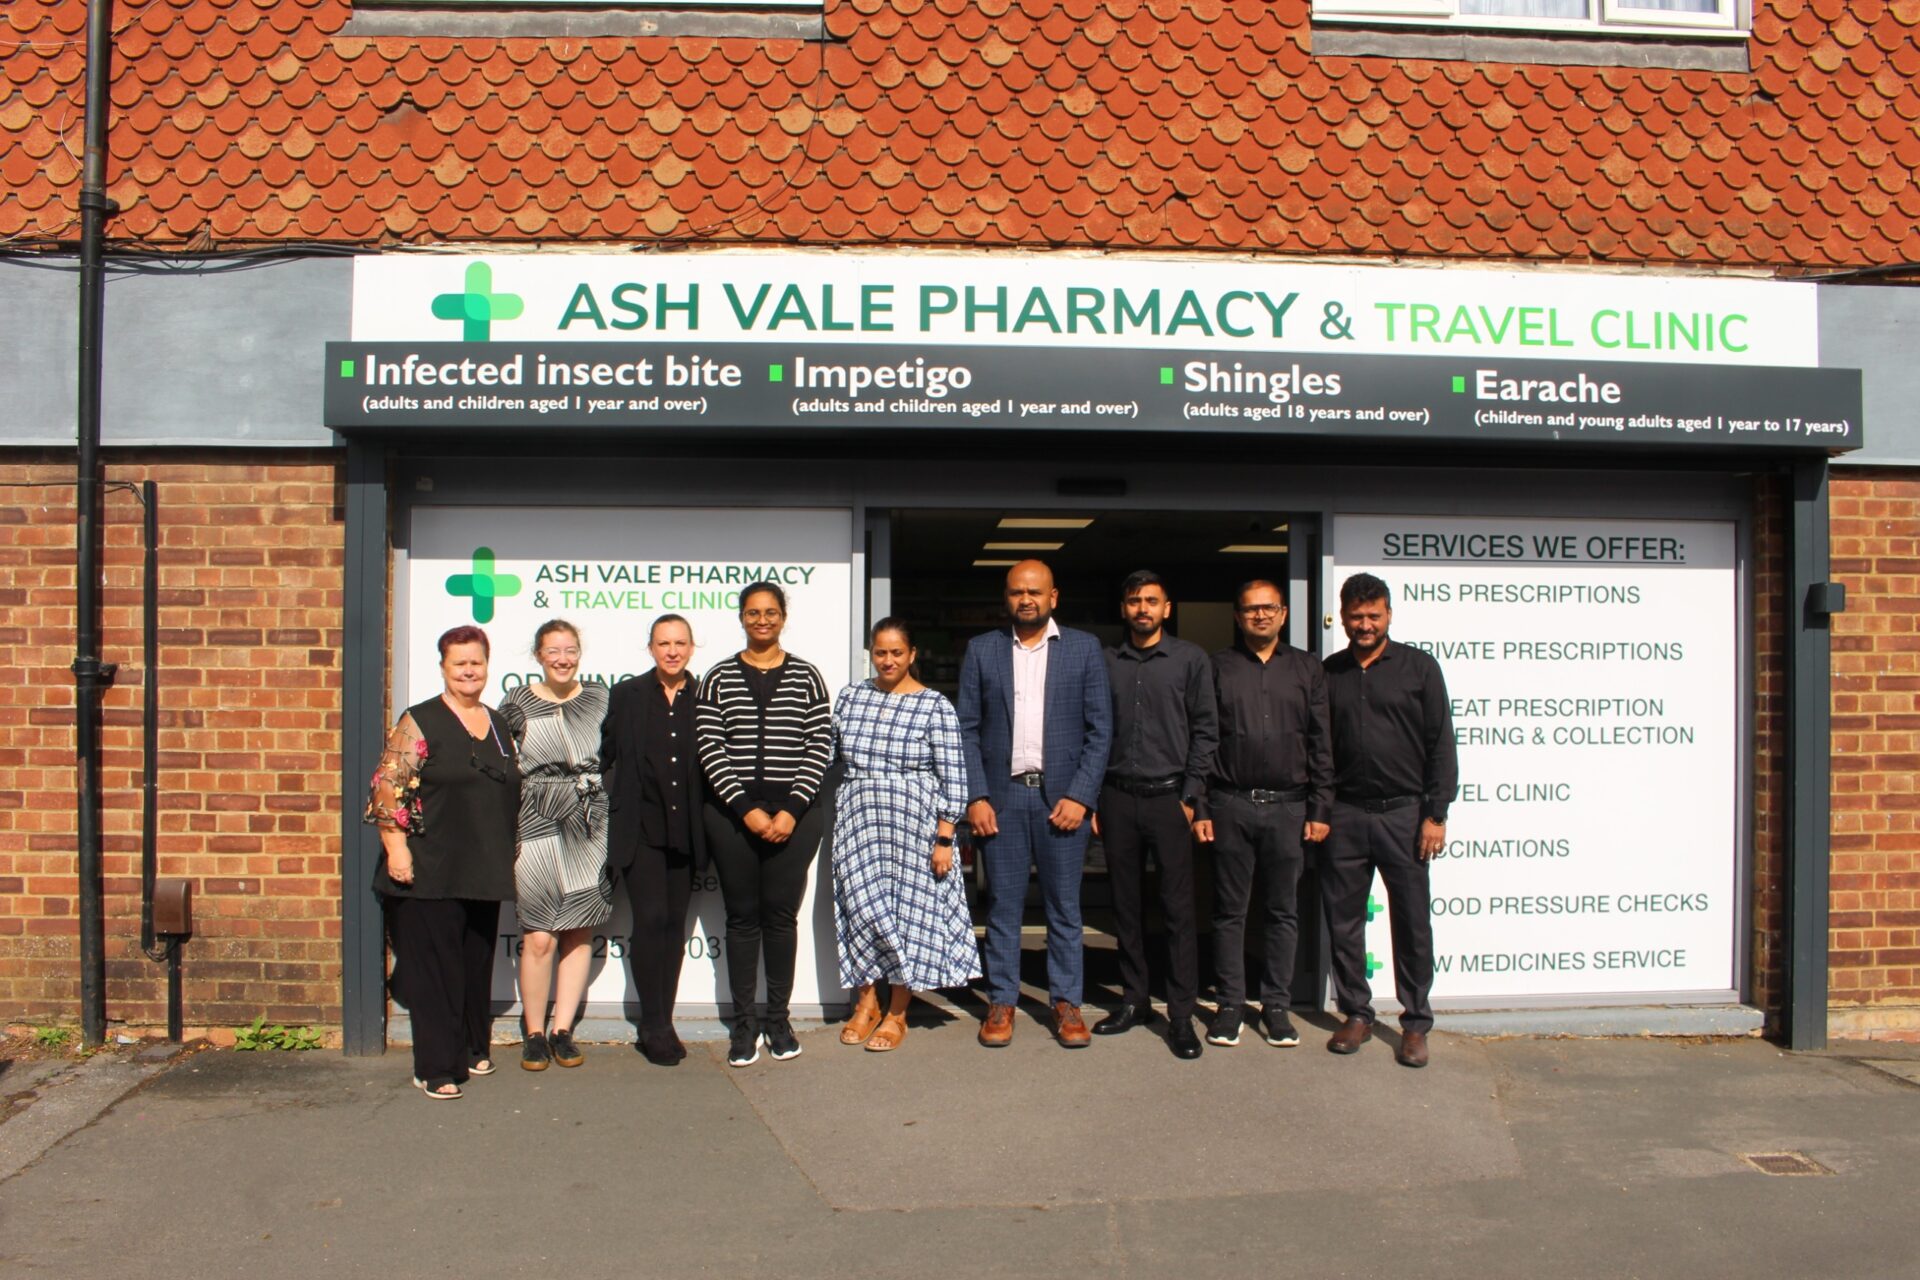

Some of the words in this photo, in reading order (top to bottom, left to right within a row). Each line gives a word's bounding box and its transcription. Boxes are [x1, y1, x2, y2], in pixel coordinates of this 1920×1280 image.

[557, 282, 700, 331] ASH
[722, 283, 895, 332] VALE
[919, 285, 1301, 338] PHARMACY
[1319, 300, 1355, 340] &
[1374, 302, 1575, 347] TRAVEL
[1590, 309, 1750, 353] CLINIC
[365, 353, 523, 386] Infected
[537, 353, 654, 386] insect
[665, 354, 742, 387] bite
[795, 356, 972, 398] Impetigo
[1183, 361, 1342, 403] Shingles
[1475, 369, 1621, 404] Earache
[362, 395, 419, 414] (adults
[422, 395, 454, 410] and
[457, 395, 525, 410] children
[529, 395, 569, 414] aged
[587, 399, 625, 414] year
[628, 396, 660, 411] and
[663, 396, 708, 415] over)
[791, 398, 850, 416] (adults
[853, 398, 885, 413] and
[889, 398, 958, 413] children
[961, 399, 1001, 418] aged
[1019, 402, 1057, 418] year
[1060, 400, 1092, 415] and
[1095, 400, 1139, 419] over)
[1182, 402, 1240, 420] (adults
[1243, 404, 1281, 422] aged
[1286, 404, 1305, 419] 18
[1308, 408, 1352, 423] years
[1355, 406, 1385, 421] and
[1388, 407, 1430, 426] over)
[1474, 409, 1543, 427] (children
[1546, 412, 1575, 427] and
[1578, 416, 1625, 432] young
[1627, 414, 1674, 429] adults
[1676, 415, 1712, 433] aged
[1727, 420, 1761, 434] year
[1763, 419, 1781, 432] to
[1785, 418, 1802, 432] 17
[1804, 419, 1850, 437] years)
[1383, 532, 1524, 558] SERVICES
[1532, 535, 1577, 559] WE
[1586, 536, 1686, 561] OFFER:
[535, 564, 589, 583] ASH
[596, 564, 661, 584] VALE
[669, 565, 815, 585] PHARMACY
[533, 590, 550, 609] &
[560, 590, 653, 610] TRAVEL
[661, 591, 740, 610] CLINIC
[1403, 583, 1452, 602] NHS
[1459, 584, 1641, 604] PRESCRIPTIONS
[1503, 641, 1683, 661] PRESCRIPTIONS
[1451, 698, 1491, 717] EAT
[1498, 698, 1664, 717] PRESCRIPTION
[1455, 726, 1524, 746] ERING
[1531, 727, 1546, 745] &
[1553, 726, 1694, 745] COLLECTION
[1496, 783, 1571, 802] CLINIC
[1431, 897, 1482, 916] OOD
[1489, 895, 1610, 915] PRESSURE
[1617, 893, 1709, 913] CHECKS
[1460, 952, 1586, 973] MEDICINES
[1593, 949, 1687, 970] SERVICE
